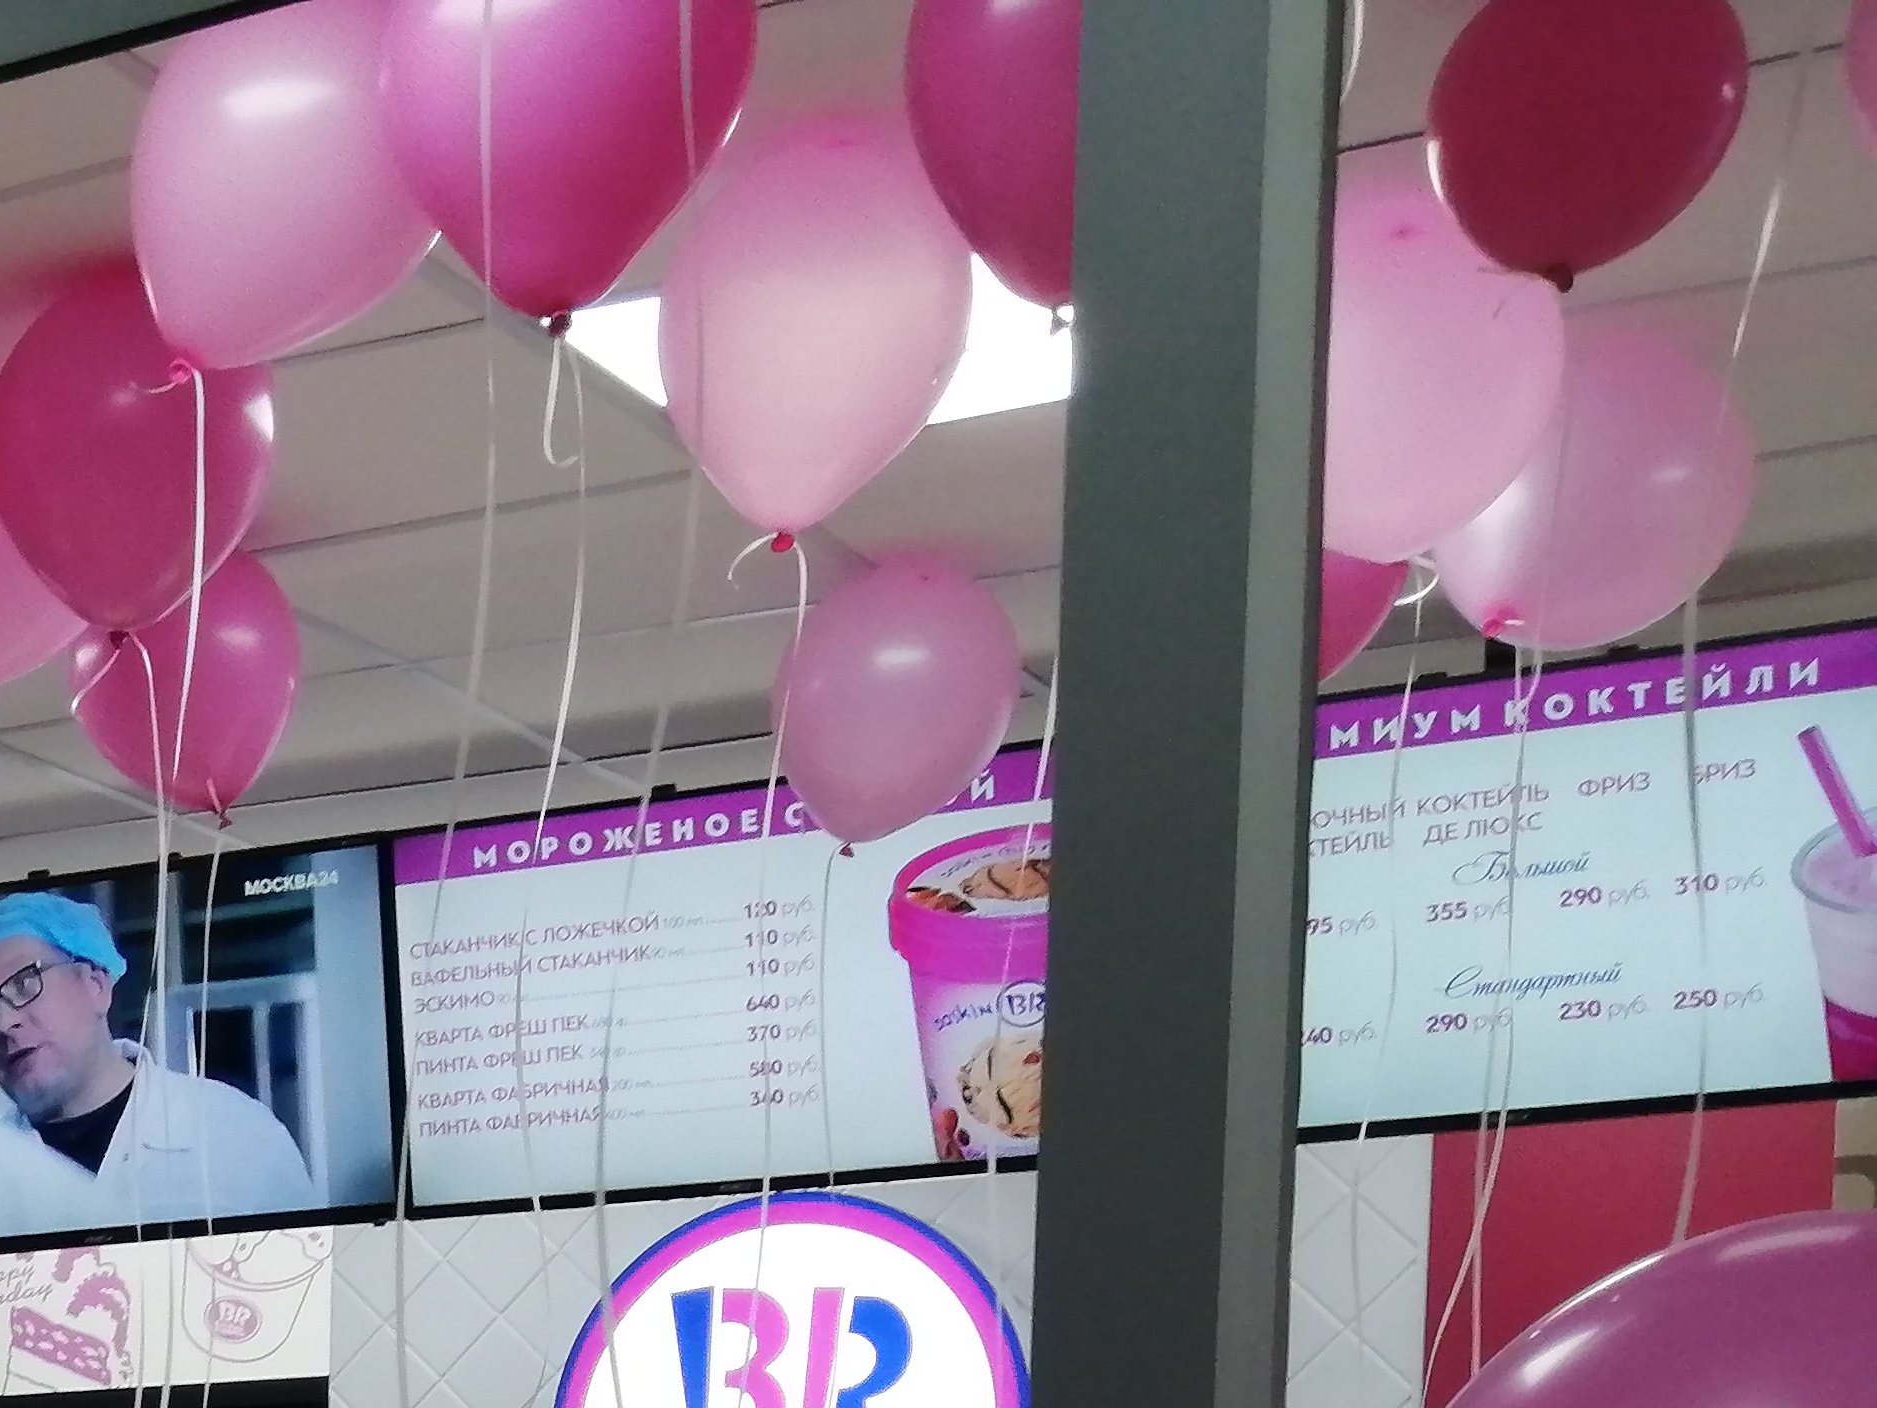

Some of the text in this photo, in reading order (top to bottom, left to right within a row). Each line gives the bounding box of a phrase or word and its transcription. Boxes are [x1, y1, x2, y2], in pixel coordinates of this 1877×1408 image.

[1503, 656, 1821, 730] КОКТЕЙЛИ
[1576, 770, 1651, 797] ФРИЗ
[472, 807, 762, 870] МОРОЖЕНОЕ
[1422, 821, 1459, 848] ДЕ
[1426, 900, 1468, 923] 355
[1559, 885, 1603, 908] 290
[1675, 872, 1720, 896] 310
[409, 930, 520, 960] СТАКАНЧИК
[542, 909, 659, 944] ЛОЖЕЧКОЙ
[536, 944, 652, 973] СТАКАНЧИК
[746, 1023, 781, 1043] 370
[1425, 1011, 1468, 1035] 290
[1558, 999, 1602, 1022] 230
[1673, 988, 1719, 1011] 250
